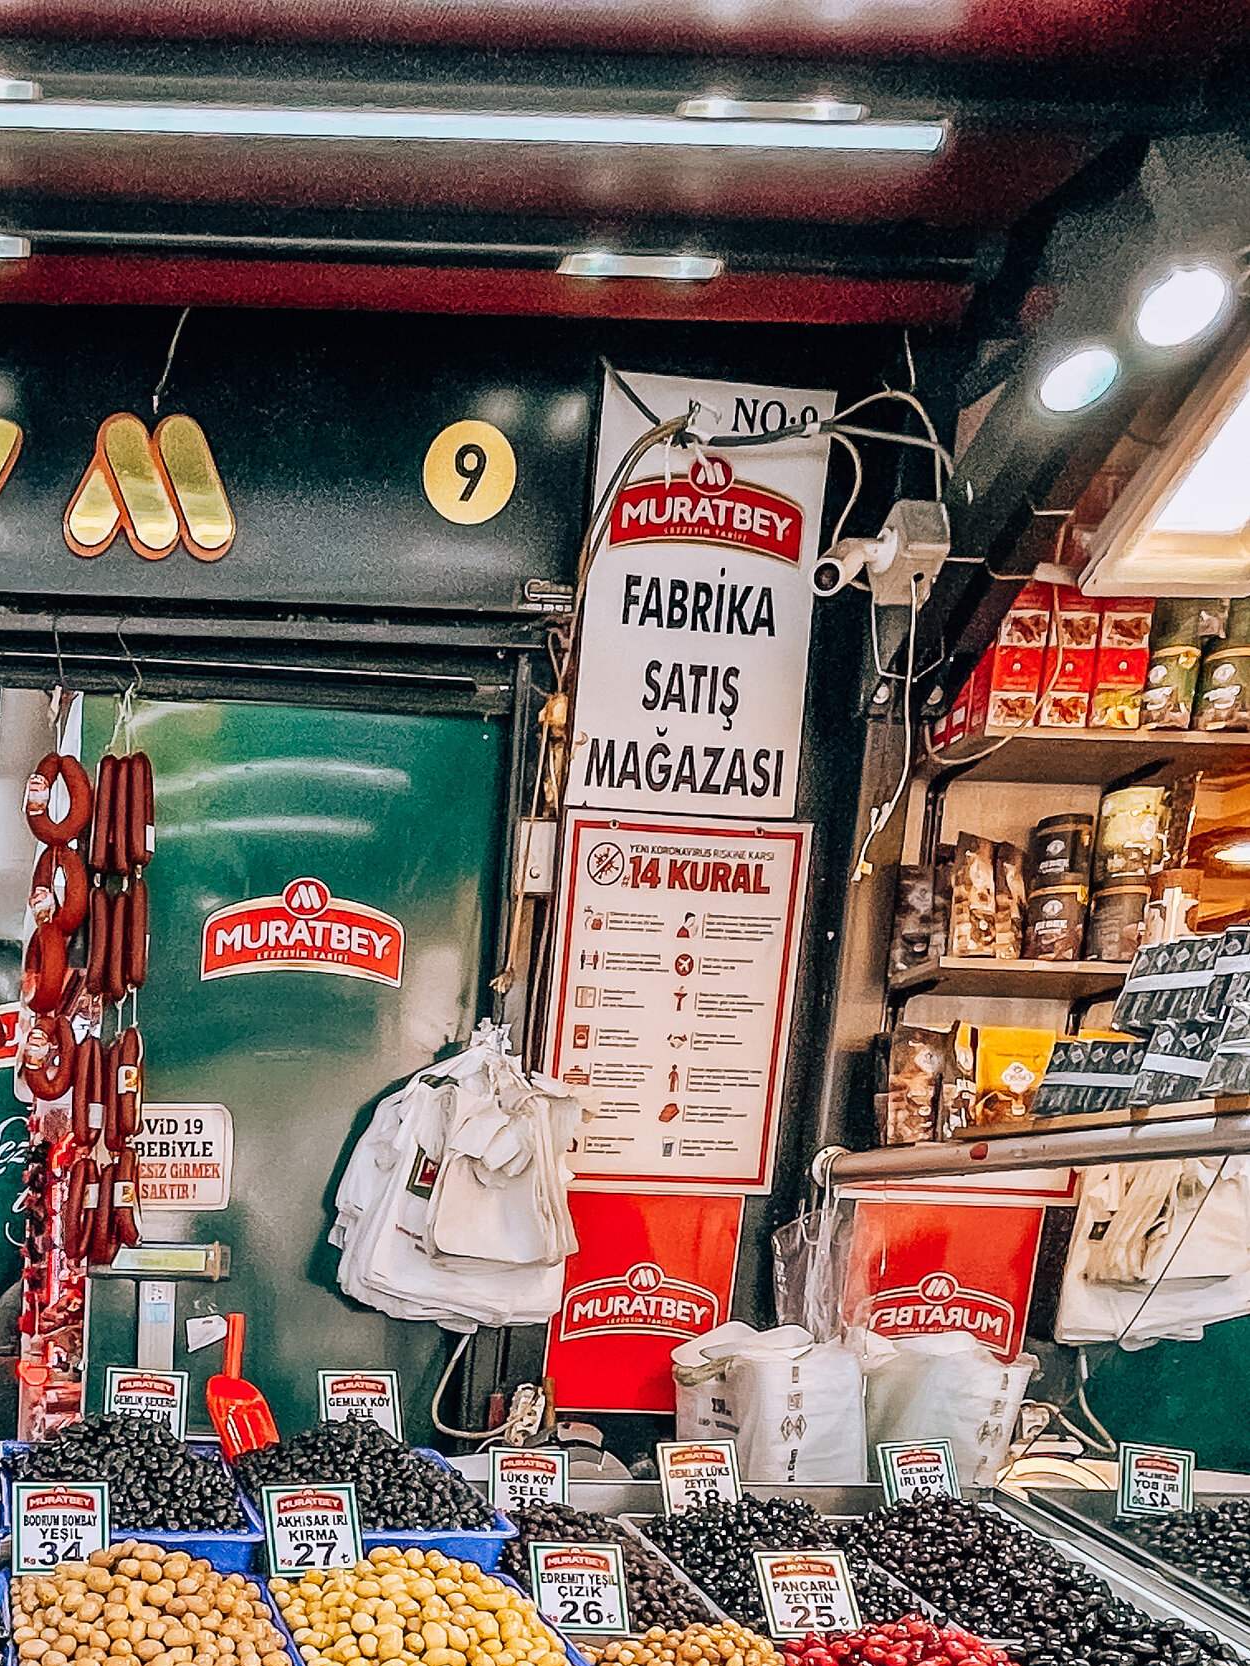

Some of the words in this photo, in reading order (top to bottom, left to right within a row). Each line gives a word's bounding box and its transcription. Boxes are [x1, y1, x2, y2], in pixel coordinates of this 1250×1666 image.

[454, 443, 488, 502] 9
[621, 496, 793, 543] MURATBEY
[622, 567, 777, 637] FABRİKA
[642, 659, 741, 730] SATIŞ
[584, 727, 785, 797] MAĞAZASI
[668, 858, 771, 894] KURAL
[215, 919, 392, 959] MURATBEY
[184, 1119, 204, 1135] 19
[572, 1296, 708, 1325] MURATBEY
[120, 1381, 172, 1392] MURATBEY
[333, 1381, 384, 1391] MURATBEY
[370, 1396, 390, 1407] KÖY
[503, 1459, 554, 1470] MURATBEY
[706, 1466, 729, 1477] LÜKS
[501, 1471, 529, 1484] LÜKS
[533, 1474, 555, 1485] KÖY
[919, 1474, 944, 1486] BOY
[508, 1485, 549, 1497] SELE
[30, 1496, 91, 1507] MURATBEY
[279, 1498, 340, 1510] MURATBEY
[23, 1515, 60, 1526] BODRUM
[288, 1529, 338, 1542] KIRMA
[24, 1557, 36, 1565] Kg
[38, 1541, 84, 1566] 34
[293, 1542, 337, 1567] 27
[547, 1556, 606, 1568] MURATBEY
[772, 1580, 841, 1593] PANCARLI
[559, 1600, 604, 1625] 26
[791, 1605, 836, 1628] 25
